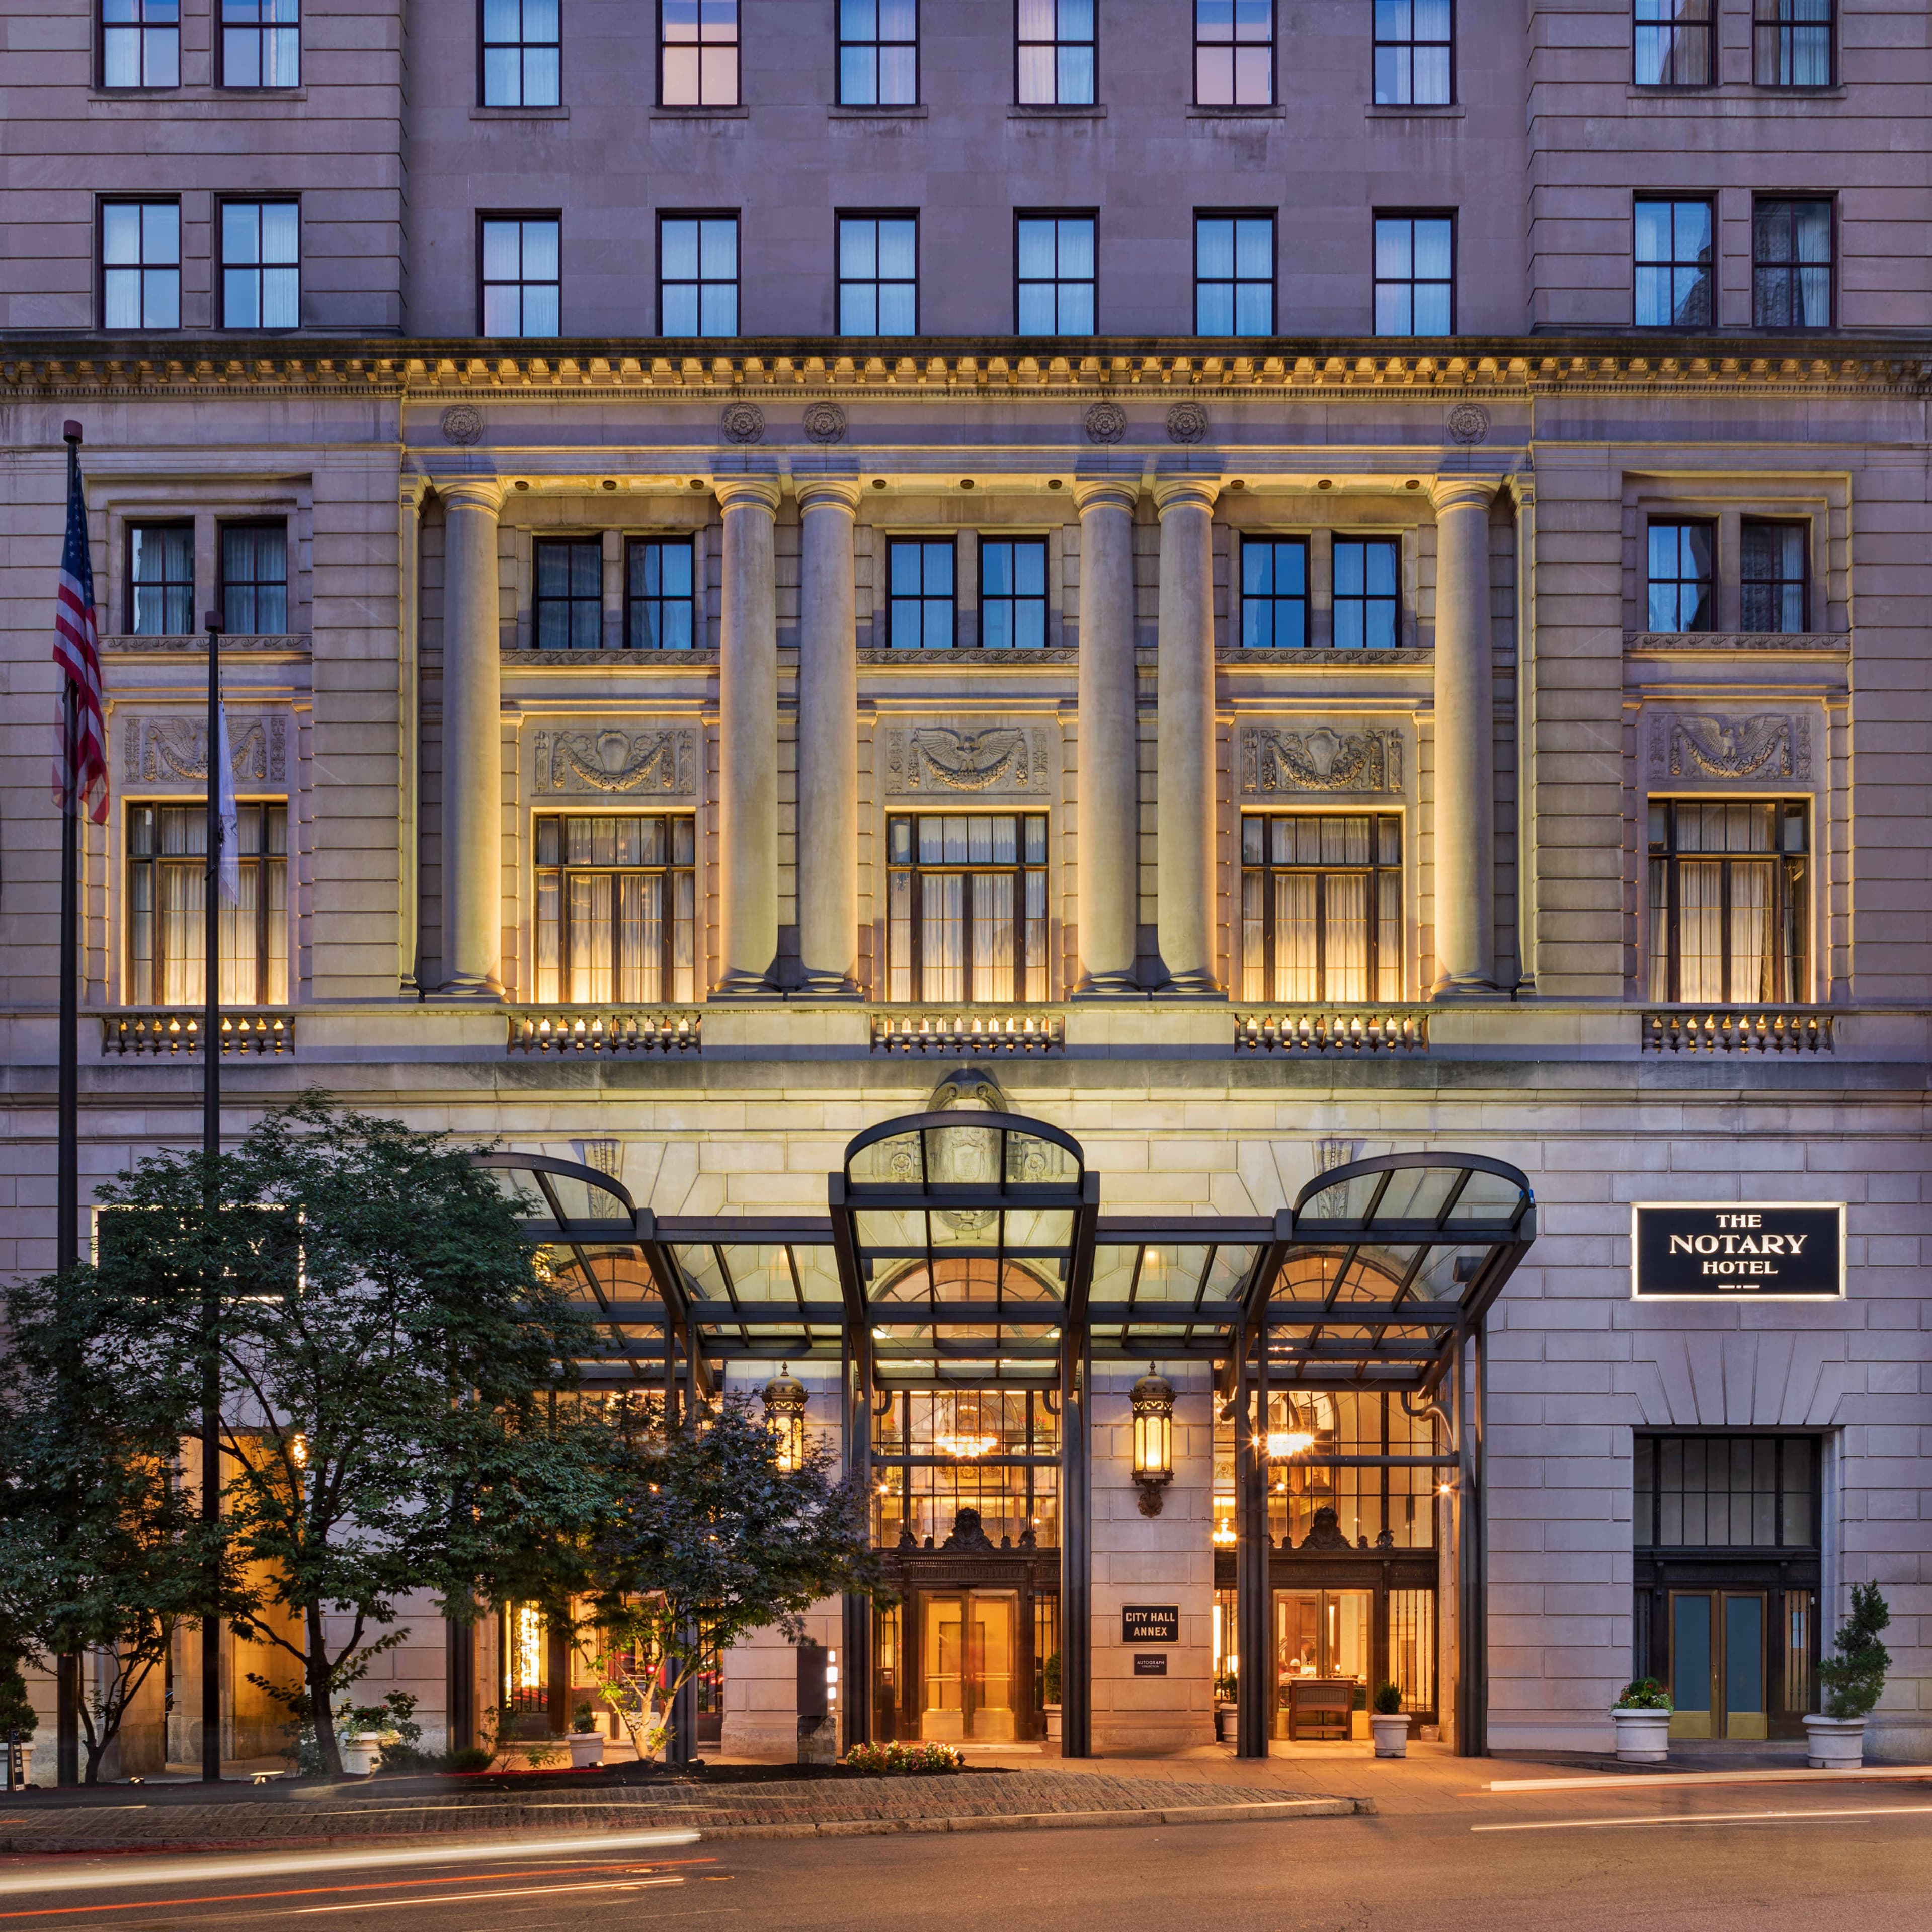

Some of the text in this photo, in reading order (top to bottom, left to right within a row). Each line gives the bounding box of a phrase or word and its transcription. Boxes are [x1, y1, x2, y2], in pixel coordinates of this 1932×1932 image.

[1716, 1214, 1762, 1228] THE
[1669, 1234, 1808, 1255] NOTARY
[1702, 1261, 1779, 1274] HOTEL
[1126, 1612, 1175, 1622] CITY HALL
[1134, 1627, 1167, 1636] ANNEX
